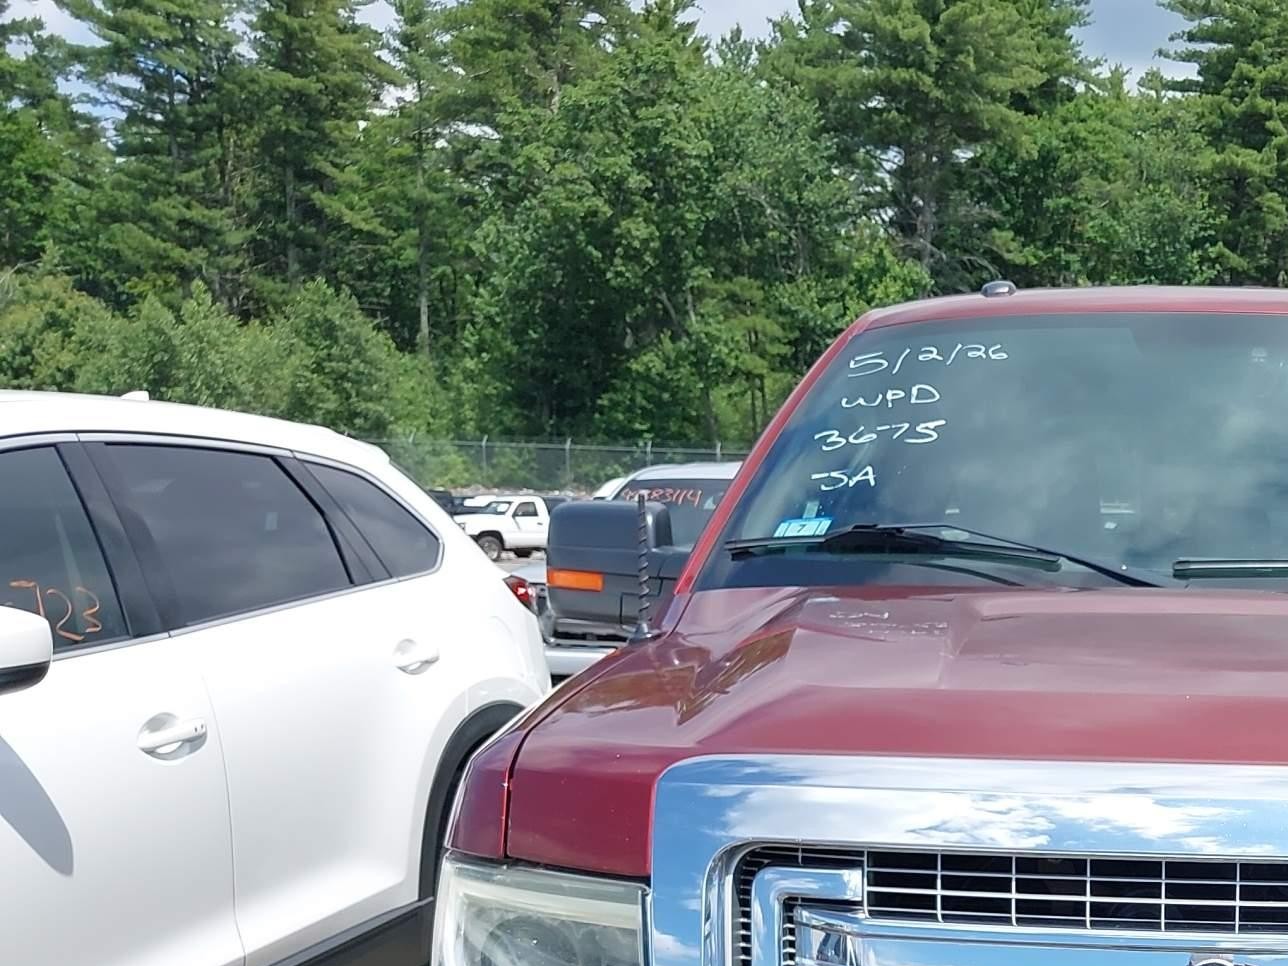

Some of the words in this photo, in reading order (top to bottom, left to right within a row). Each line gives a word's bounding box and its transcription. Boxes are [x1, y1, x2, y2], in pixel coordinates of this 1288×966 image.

[848, 343, 1010, 377] 5/2/26
[841, 383, 941, 409] WPD
[813, 419, 947, 452] 3675
[8, 578, 102, 642] 723
